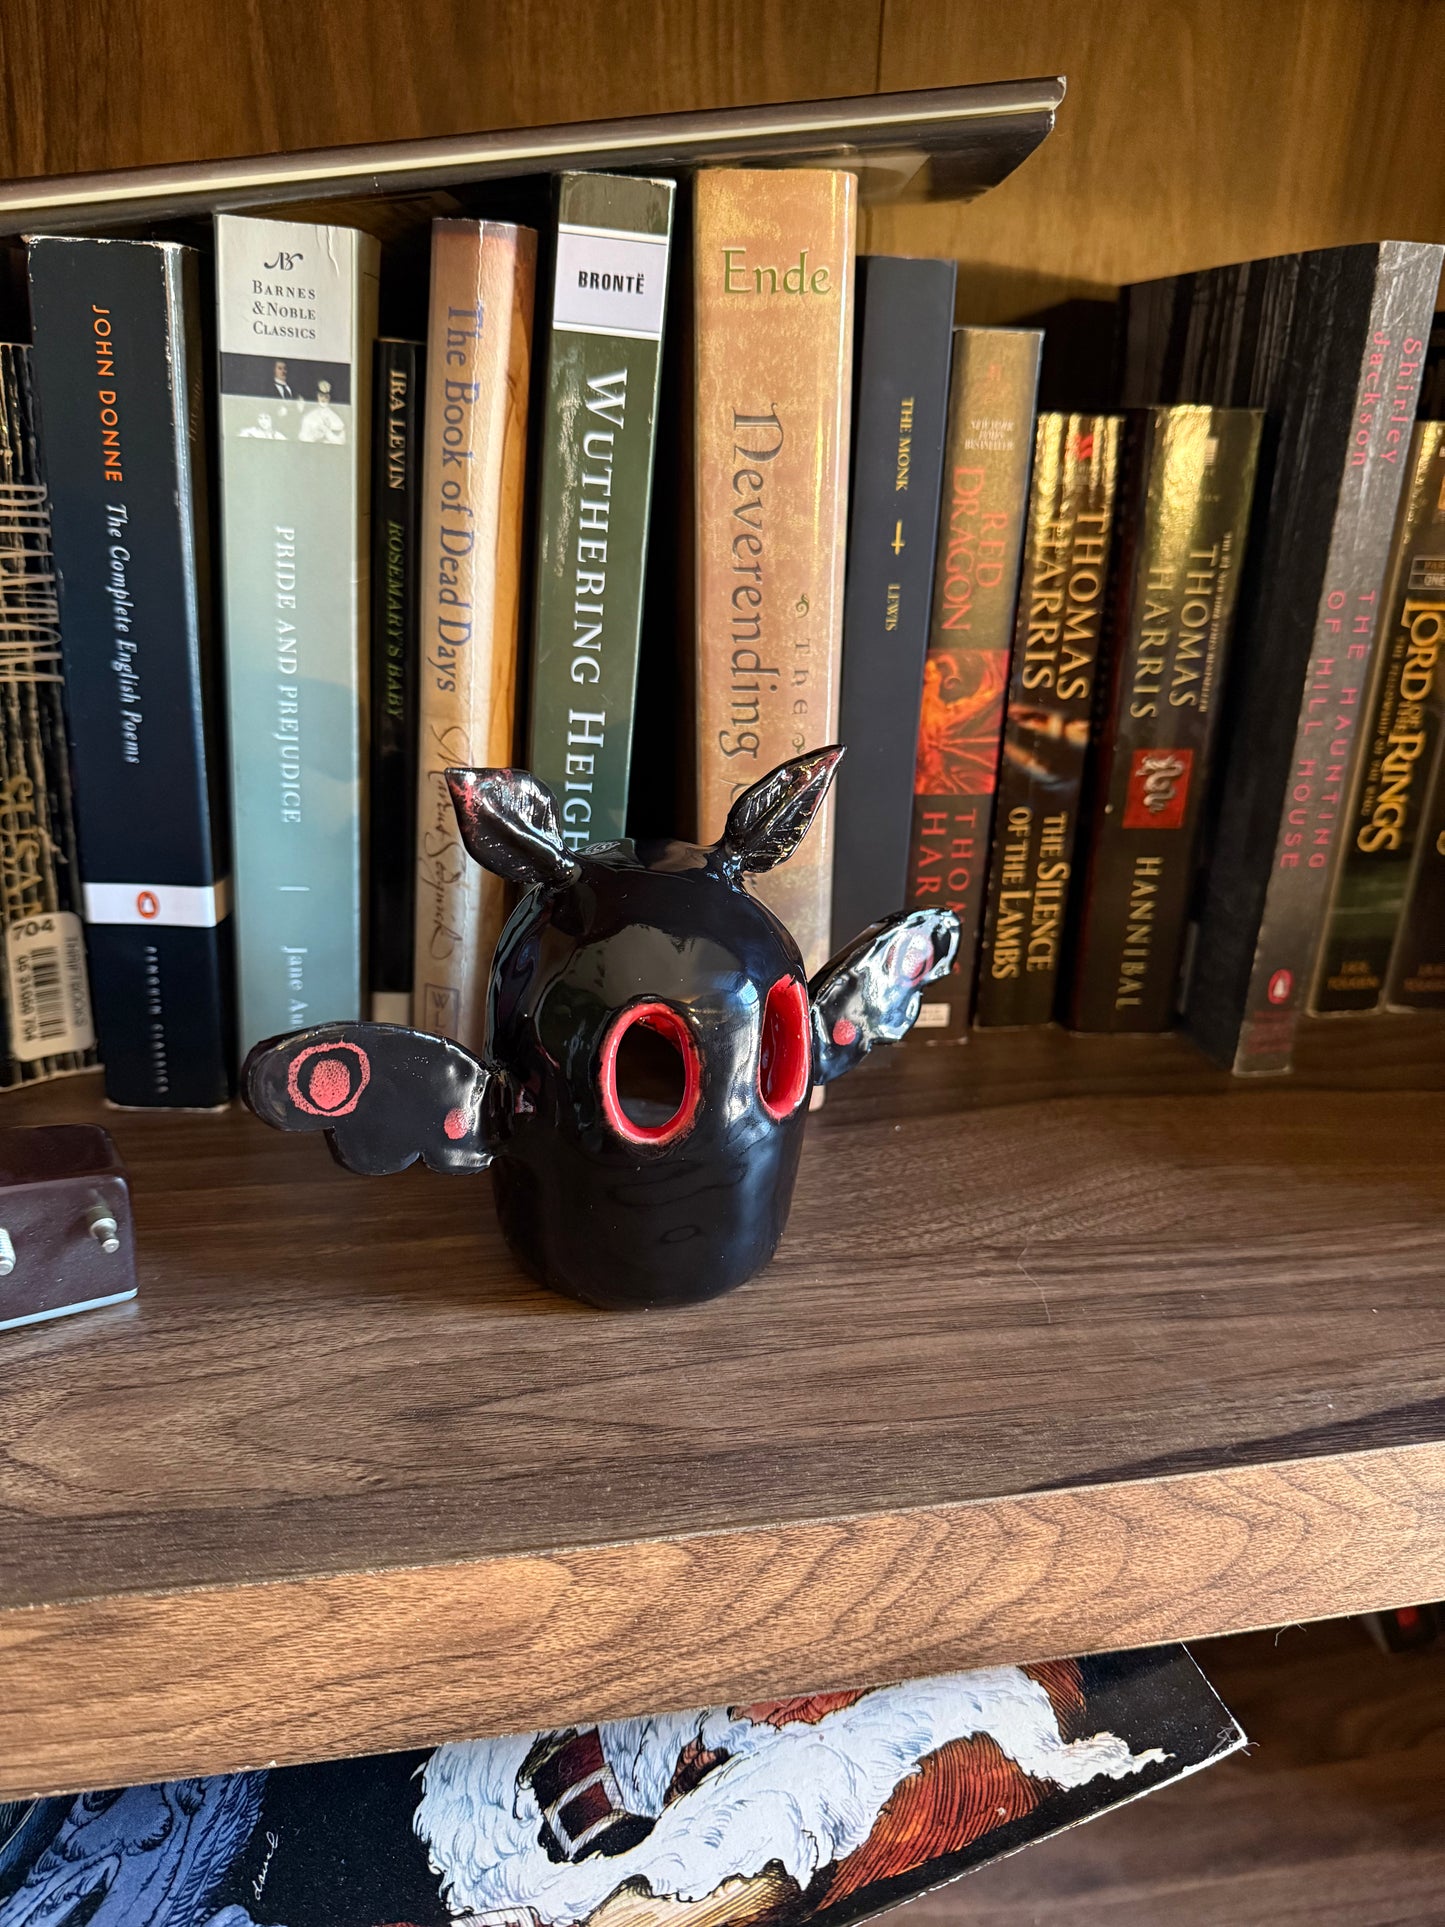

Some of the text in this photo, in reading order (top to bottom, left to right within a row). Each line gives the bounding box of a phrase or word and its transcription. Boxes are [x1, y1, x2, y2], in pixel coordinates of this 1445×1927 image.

[252, 280, 316, 300] BARNES
[252, 321, 317, 340] CLASSICS
[577, 269, 645, 296] BRONTË
[722, 247, 833, 296] Ende
[92, 304, 123, 482] JOHN DONNE
[389, 369, 407, 491] IRA LEVIN
[896, 397, 916, 492] THE MONK
[1351, 331, 1392, 467] Jackson
[1378, 336, 1423, 464] Shirley
[426, 304, 484, 694] The Book of Dead Days
[570, 368, 628, 686] WUTHERING
[942, 467, 985, 631] DRAGON
[975, 509, 1008, 588] RED
[105, 503, 143, 765] The Complete English Poems
[384, 520, 405, 720] ROSEMARY'S BABY
[718, 402, 785, 760] Neverending
[884, 583, 902, 632] LEWIS
[1022, 520, 1068, 690] HARRIS
[1057, 505, 1110, 700] THOMAS
[1129, 565, 1176, 719] HARRIS
[1168, 545, 1219, 707] THOMAS
[1401, 598, 1445, 700] LORD
[272, 526, 302, 824] PRIDE AND PREJUDICE
[1280, 591, 1345, 870] OF HILL HOUSE
[1309, 590, 1376, 869] THE HAUNTING
[915, 812, 947, 897] HAR
[1357, 732, 1427, 852] RINGS
[13, 918, 55, 942] 704
[281, 946, 308, 991] Jane
[991, 807, 1033, 979] OF THE LAMBS
[1026, 812, 1071, 972] THE SILENCE
[1115, 856, 1165, 1010] HANNIBAL
